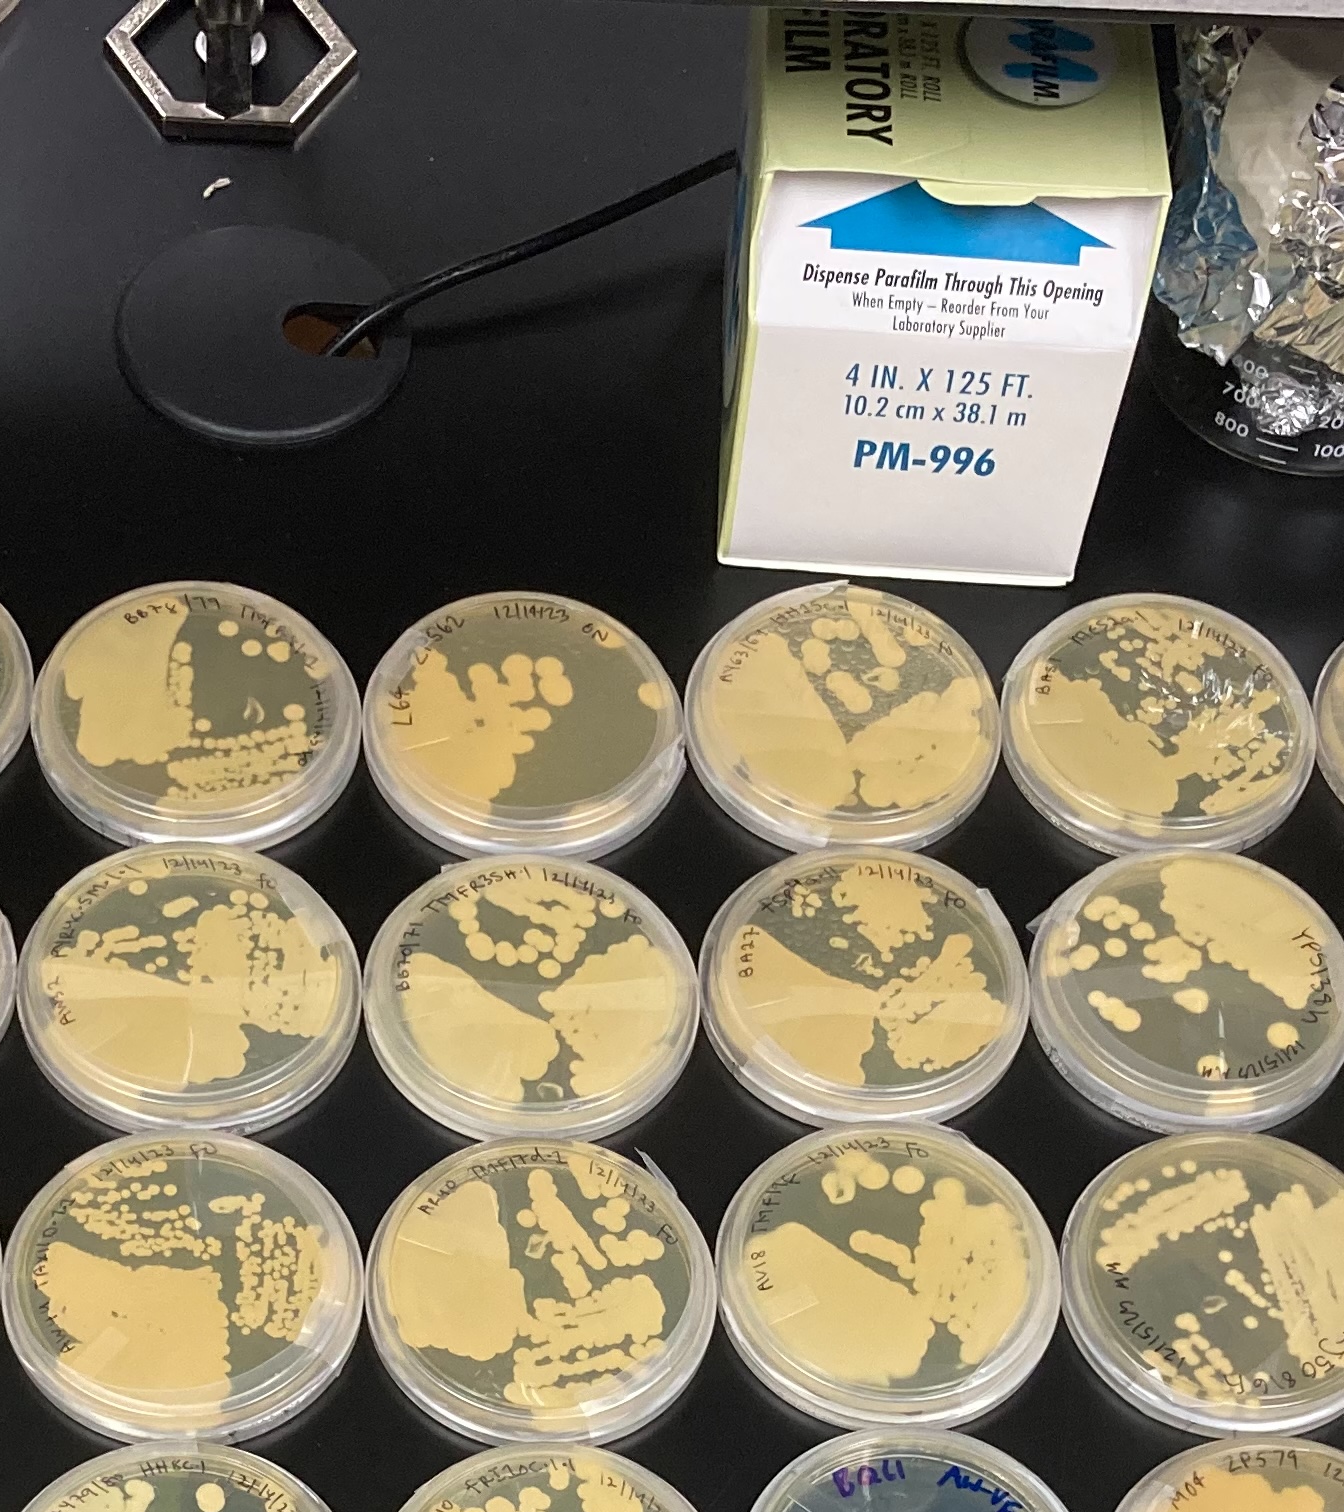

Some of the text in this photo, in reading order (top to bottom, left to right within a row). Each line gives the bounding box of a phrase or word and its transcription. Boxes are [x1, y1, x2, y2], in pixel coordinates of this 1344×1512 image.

[803, 263, 1104, 307] Dispense Parafilm Through This Opening
[852, 291, 1049, 320] When Empty Reorder From Your
[892, 316, 1006, 340] Laboratory Supplier
[845, 363, 1033, 398] 4 IN. X 125 FT.
[844, 394, 1027, 427] 10.2 cm x 38.1 m
[1214, 411, 1249, 437] 800
[853, 439, 996, 477] PM-996
[728, 924, 771, 978] BA27
[749, 1248, 773, 1292] AV18
[1222, 1448, 1301, 1475] ZP579
